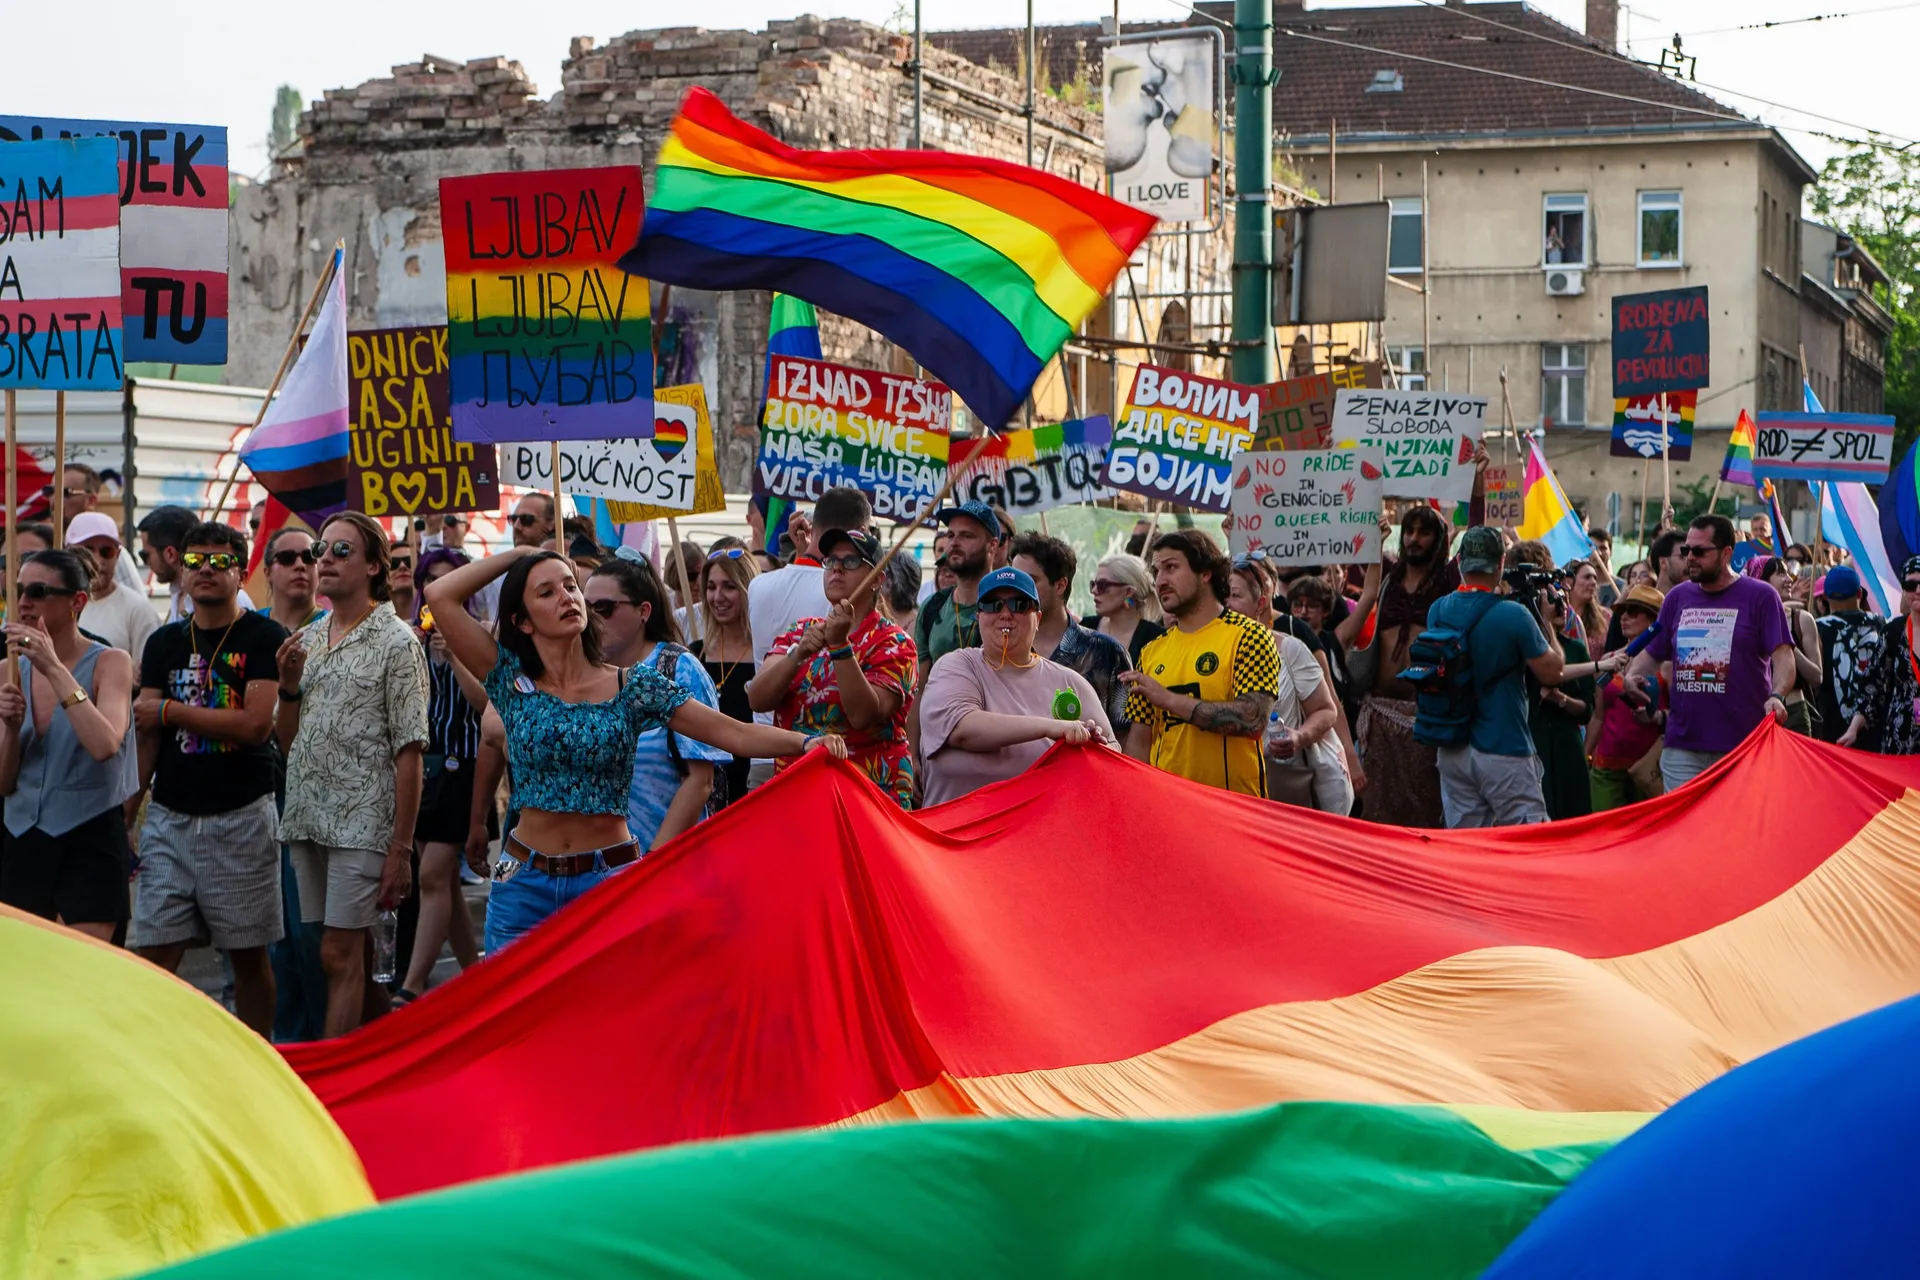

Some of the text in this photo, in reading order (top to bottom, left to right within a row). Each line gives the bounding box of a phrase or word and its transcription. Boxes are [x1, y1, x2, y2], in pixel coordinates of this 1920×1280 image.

[1127, 182, 1189, 202] I LOVE
[465, 187, 627, 260] LJUBAV
[131, 277, 206, 344] TU
[471, 269, 629, 338] LJUBAV
[349, 328, 448, 379] DNIČK
[1643, 329, 1674, 354] ZA
[778, 362, 872, 407] IZNAD
[1332, 366, 1367, 392] SE
[349, 377, 434, 430] ASA
[1134, 368, 1259, 433] ВОЛИМ
[767, 398, 839, 440] ZORA
[1366, 417, 1453, 435] SLOBODA
[765, 432, 844, 470] NAŠA
[1758, 428, 1789, 457] ROD
[1829, 431, 1885, 461] SPOL
[517, 447, 695, 502] BUDUĆNOST
[1108, 447, 1232, 509] БОЈИМ
[1256, 458, 1286, 476] NO
[1299, 479, 1314, 490] IN
[1238, 514, 1262, 531] NO
[1275, 512, 1331, 527] QUEER
[1293, 530, 1309, 541] IN
[1676, 669, 1695, 681] FREE
[1676, 681, 1726, 694] PALESTINE
